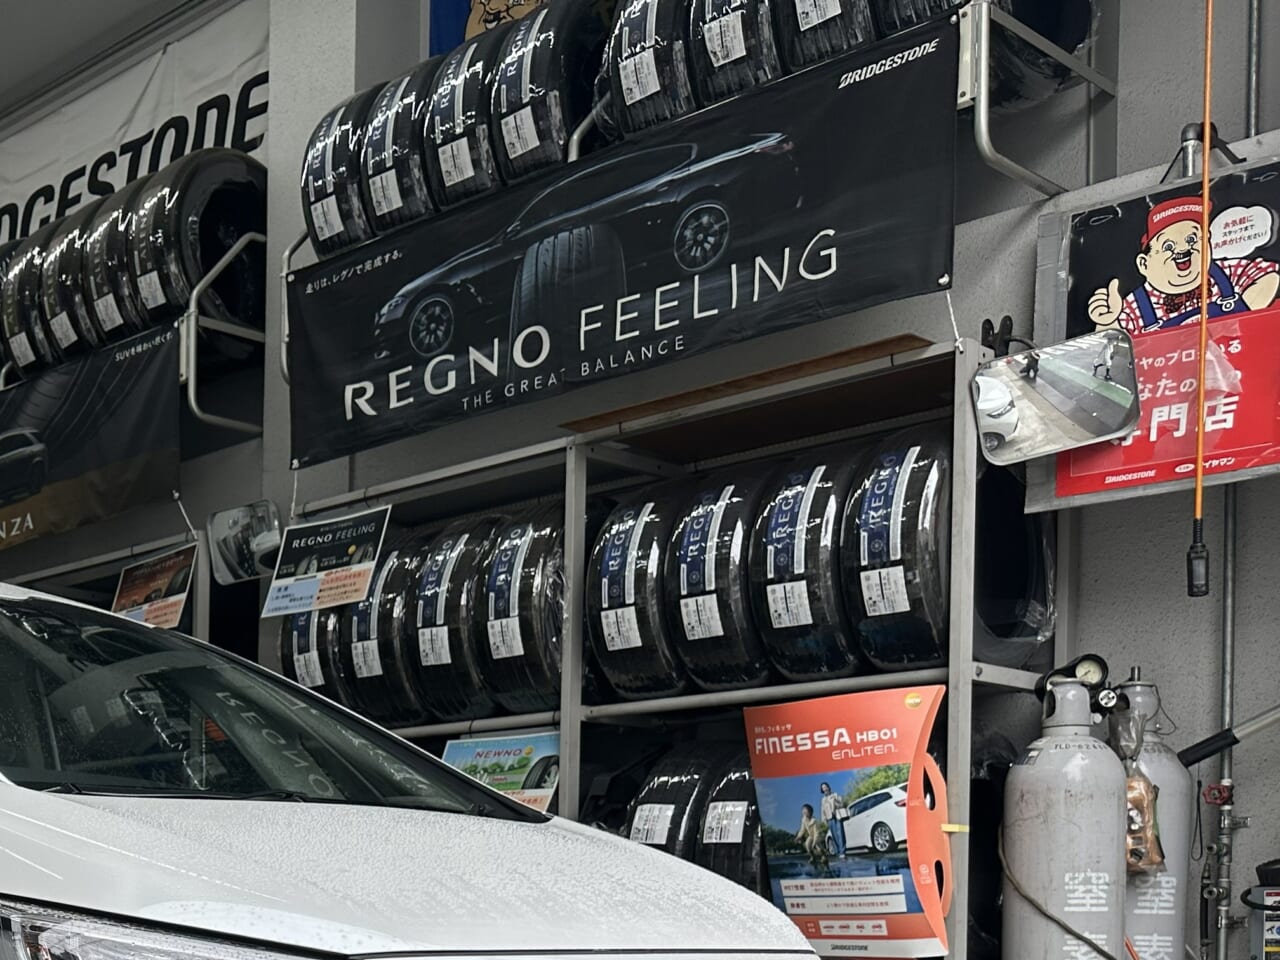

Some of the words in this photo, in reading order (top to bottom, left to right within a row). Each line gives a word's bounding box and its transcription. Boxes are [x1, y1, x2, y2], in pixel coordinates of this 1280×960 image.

[837, 38, 940, 90] BRIDGESTONE
[344, 325, 550, 421] REGNO
[578, 228, 838, 352] FEELING
[462, 389, 493, 412] THE
[580, 335, 686, 377] BALANCE
[1120, 395, 1240, 447] 門店
[1104, 469, 1157, 484] BRIDGESTONE
[292, 533, 333, 549] REGNO
[335, 522, 376, 540] FEELING
[475, 748, 522, 759] NEWNO
[755, 728, 852, 755] FINESSA
[856, 728, 898, 744] HB01
